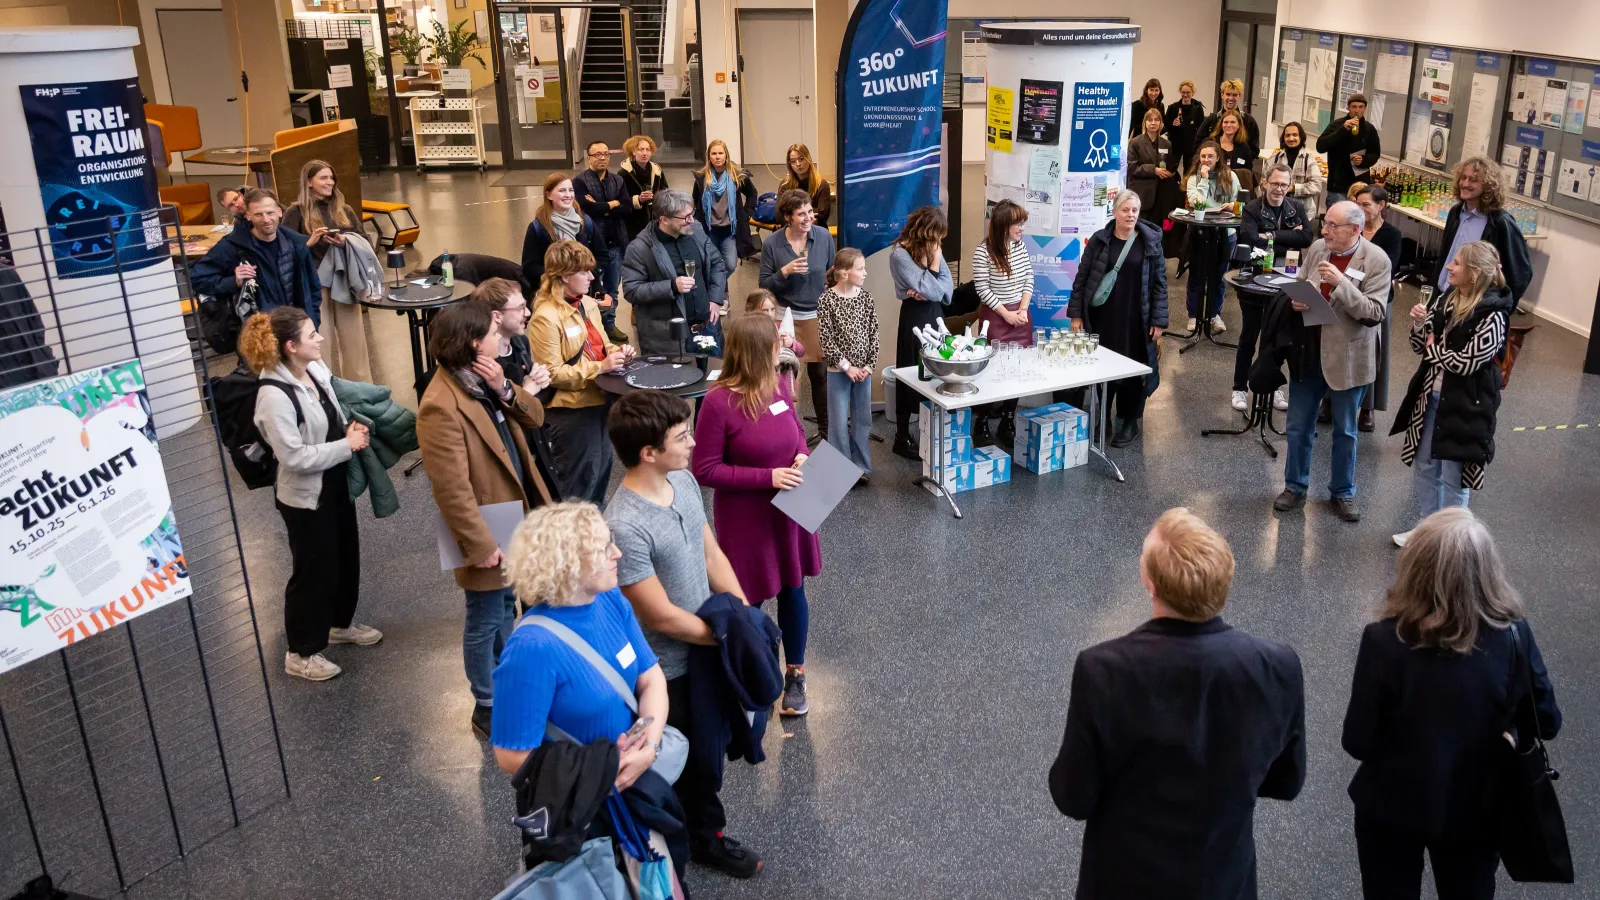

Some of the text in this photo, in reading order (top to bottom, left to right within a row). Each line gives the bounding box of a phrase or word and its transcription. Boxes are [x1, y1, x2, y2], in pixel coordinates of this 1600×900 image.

[858, 48, 904, 76] 360°
[862, 69, 938, 97] ZUKUNFT
[1078, 86, 1110, 97] Healthy
[1097, 97, 1118, 105] laude!
[66, 106, 130, 132] FREI-
[72, 128, 144, 158] RAUM
[78, 155, 146, 173] ORGANISATIONS-
[80, 168, 144, 185] ENTWICKLUNG
[1030, 254, 1062, 264] oPrax
[16, 434, 56, 462] einzigartige
[0, 468, 67, 516] acht.
[14, 446, 138, 531] ZUKUNFT
